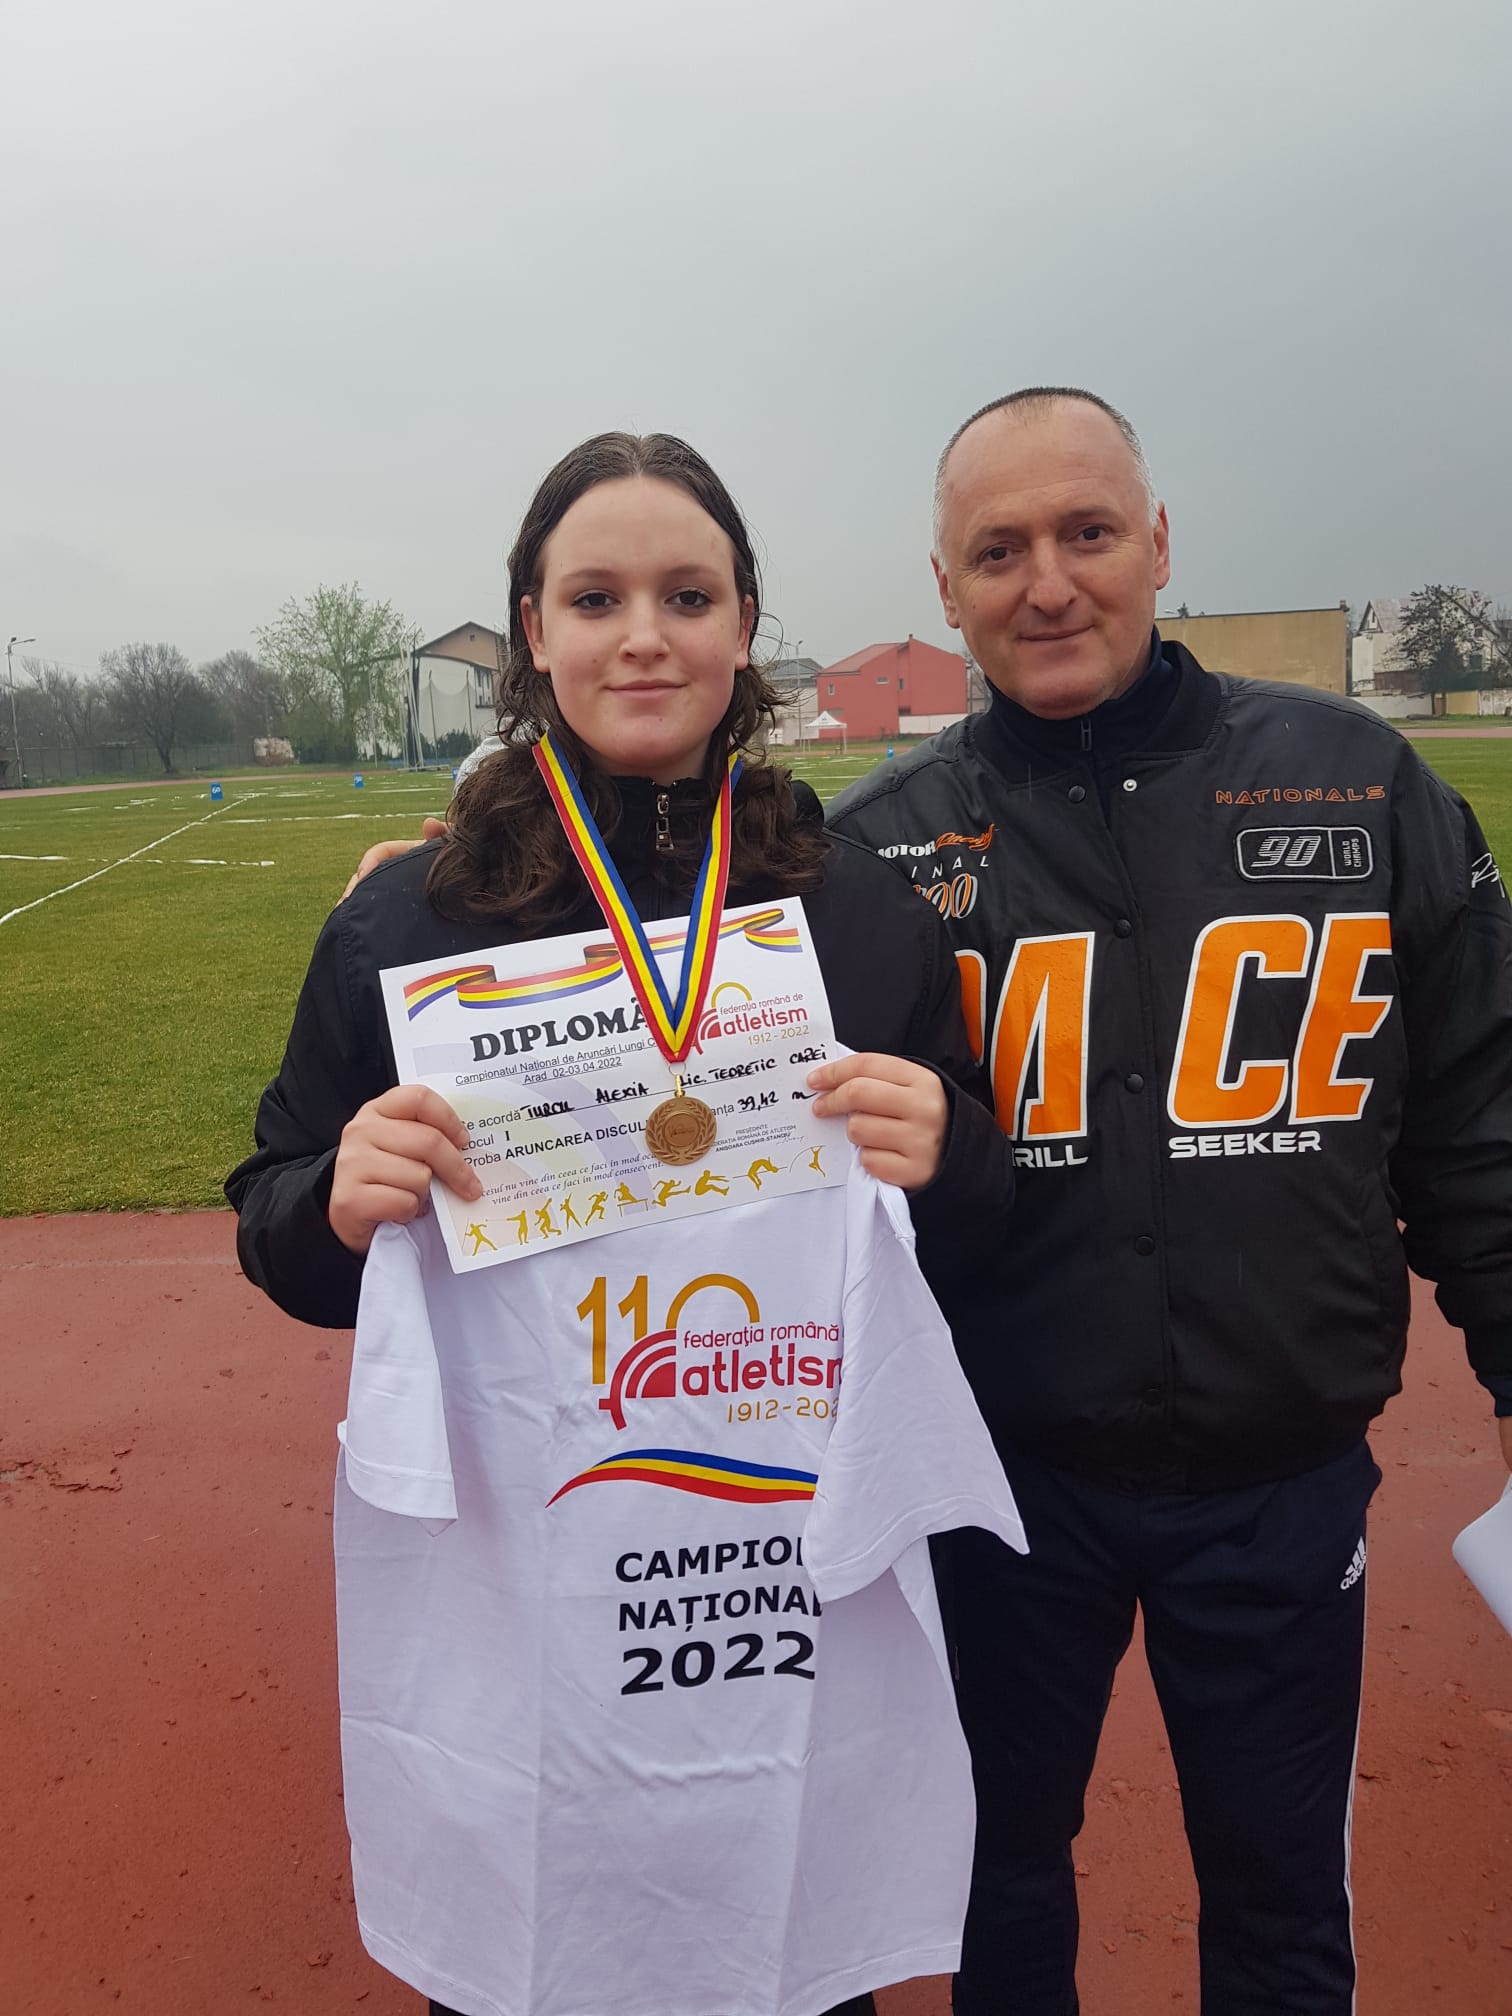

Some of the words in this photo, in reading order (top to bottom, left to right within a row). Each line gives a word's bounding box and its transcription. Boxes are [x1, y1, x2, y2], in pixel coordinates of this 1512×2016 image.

[1215, 785, 1386, 806] NATIONALS
[911, 855, 989, 879] INAL
[1250, 835, 1321, 868] 90
[792, 992, 804, 1001] de
[723, 1007, 808, 1036] atletism
[455, 1065, 518, 1085] Campionatul
[562, 1052, 575, 1063] de
[619, 1039, 645, 1053] Lungi
[524, 1072, 547, 1083] Arad
[552, 1057, 622, 1078] 02-03.04.2022
[479, 1109, 521, 1128] acordă
[505, 1133, 593, 1160] ARUNCAREA
[596, 1119, 648, 1140] DISCUL
[1012, 1144, 1089, 1168] RILL
[1168, 1130, 1322, 1159] SEEKER
[519, 1177, 539, 1187] vine
[541, 1172, 556, 1183] din
[558, 1169, 577, 1179] ceea
[579, 1166, 589, 1174] ce
[621, 1152, 641, 1165] mod
[492, 1195, 511, 1205] vine
[513, 1189, 529, 1200] din
[530, 1185, 550, 1196] ceea
[552, 1183, 561, 1191] ce
[594, 1169, 614, 1181] mod
[771, 1321, 840, 1342] română
[615, 1535, 803, 1582] CAMPIO
[620, 1630, 816, 1696] 2022
